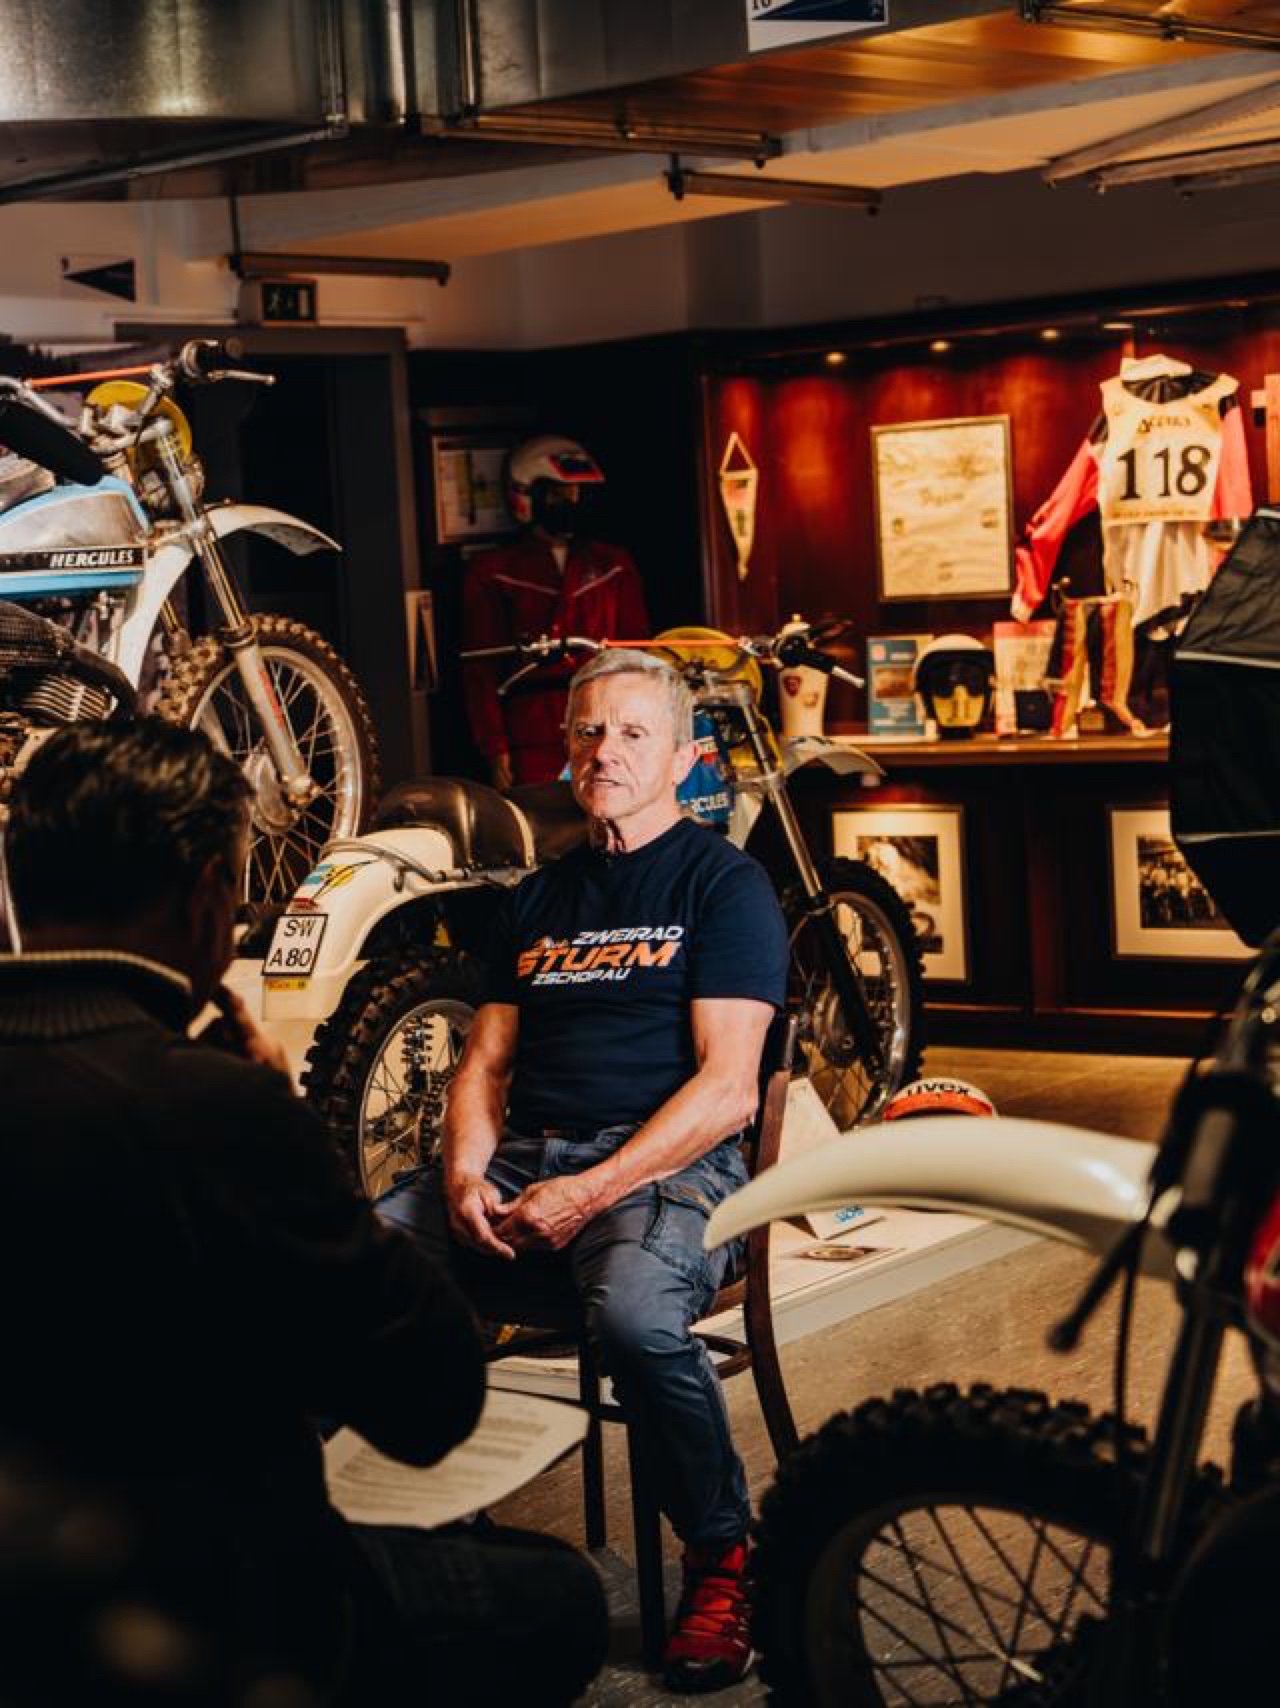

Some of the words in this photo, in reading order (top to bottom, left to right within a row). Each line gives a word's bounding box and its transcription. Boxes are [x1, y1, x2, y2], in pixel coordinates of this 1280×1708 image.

[1117, 444, 1211, 501] 118
[50, 550, 134, 569] HERCULES
[284, 919, 317, 938] SW
[571, 925, 685, 945] ZWEIRAD
[517, 941, 682, 978] STURM
[531, 968, 631, 987] ZSCHOPAU
